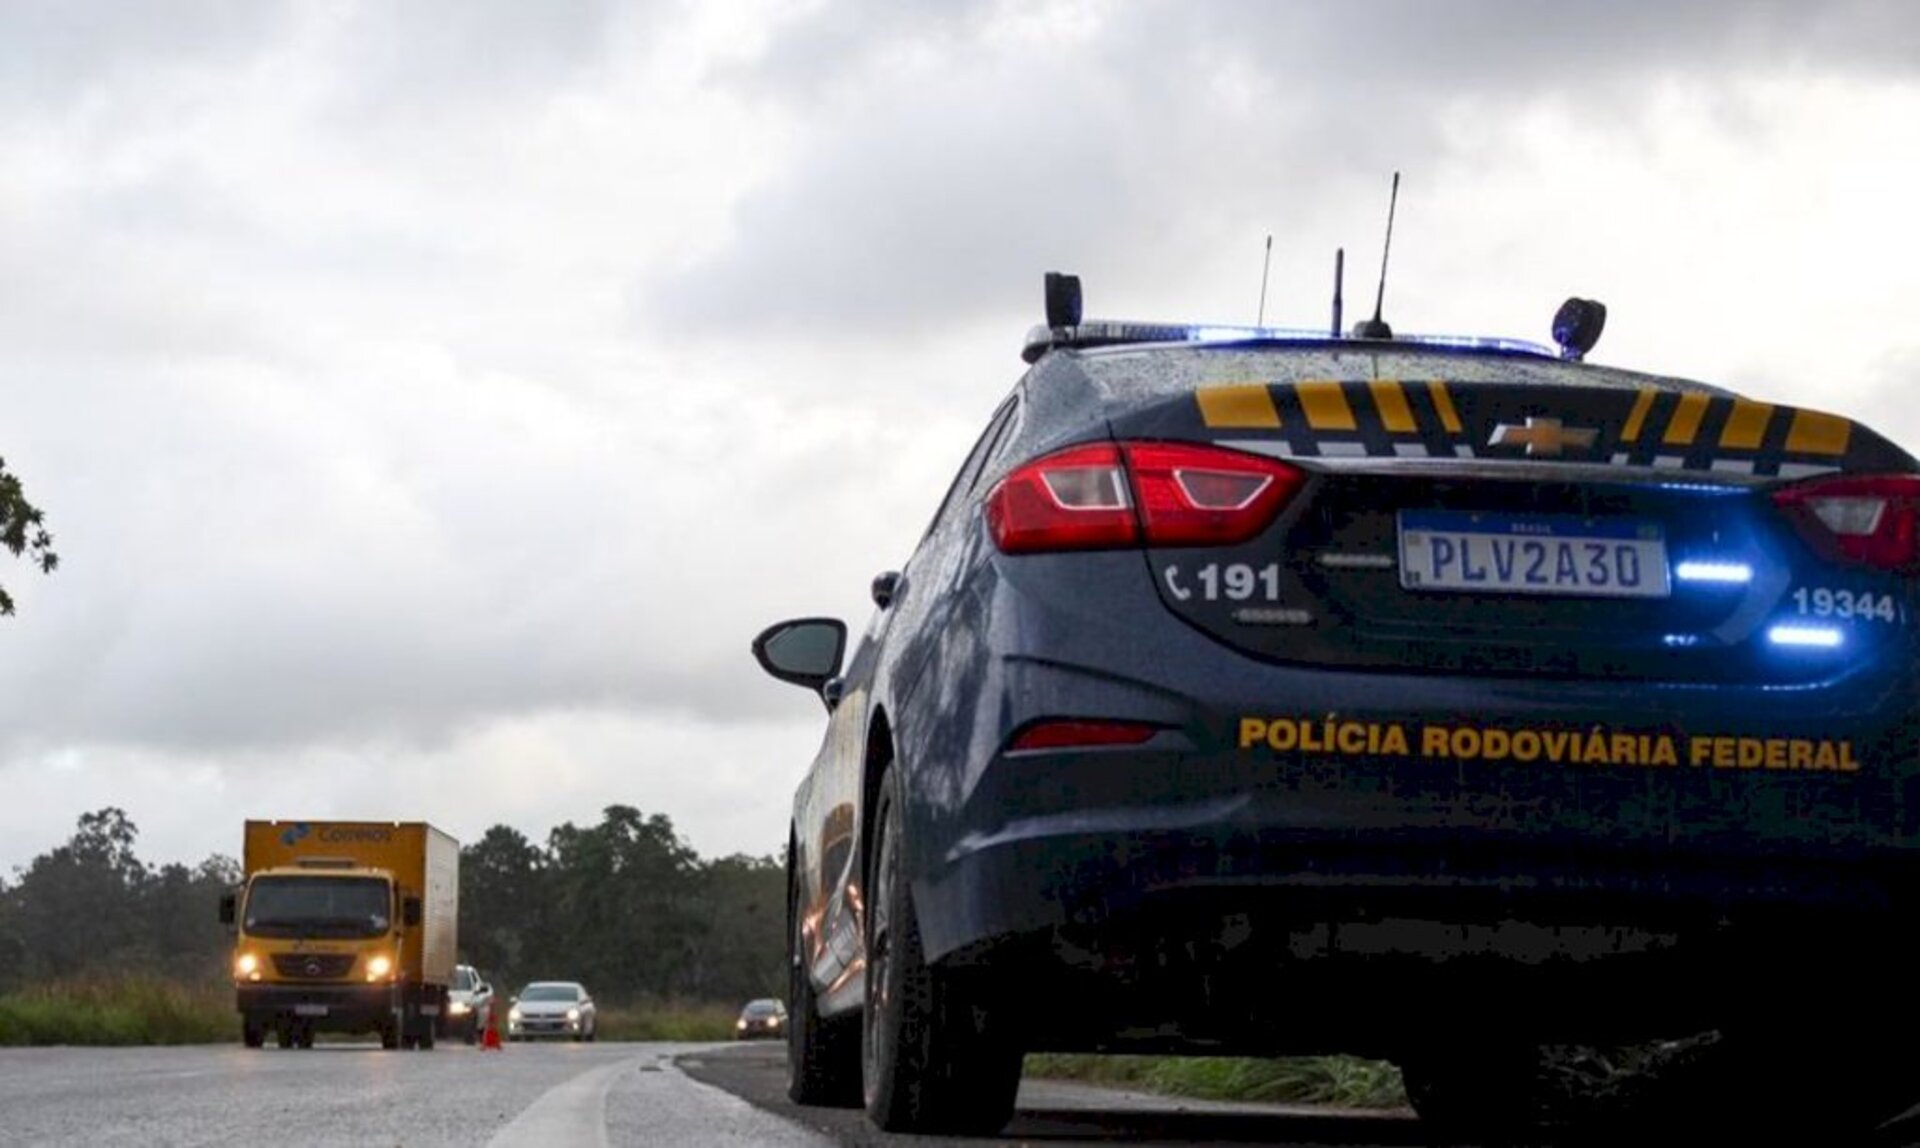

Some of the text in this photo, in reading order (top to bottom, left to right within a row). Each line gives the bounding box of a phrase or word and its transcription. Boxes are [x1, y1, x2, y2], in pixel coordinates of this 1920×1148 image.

[1197, 562, 1279, 601] 191
[1429, 535, 1641, 588] PLV2A30
[1792, 586, 1895, 623] 19344
[1239, 711, 1860, 771] POLÍCIA RODOVIÁRIA FEDERAL
